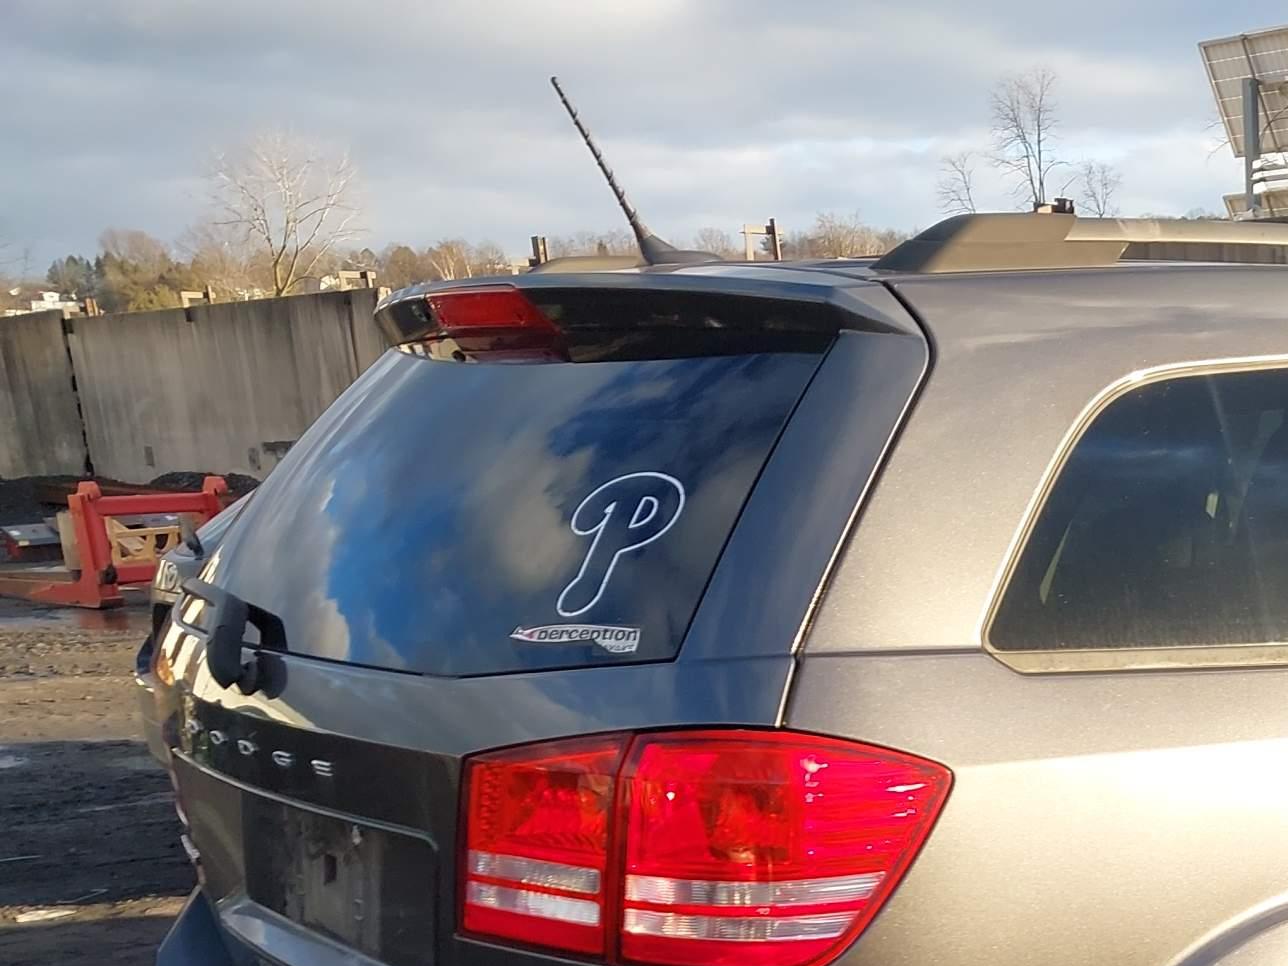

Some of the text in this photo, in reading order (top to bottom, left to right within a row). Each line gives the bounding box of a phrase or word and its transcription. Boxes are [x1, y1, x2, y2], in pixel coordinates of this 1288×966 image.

[557, 471, 685, 617] P
[537, 629, 637, 641] perception
[186, 719, 334, 777] DODGE
